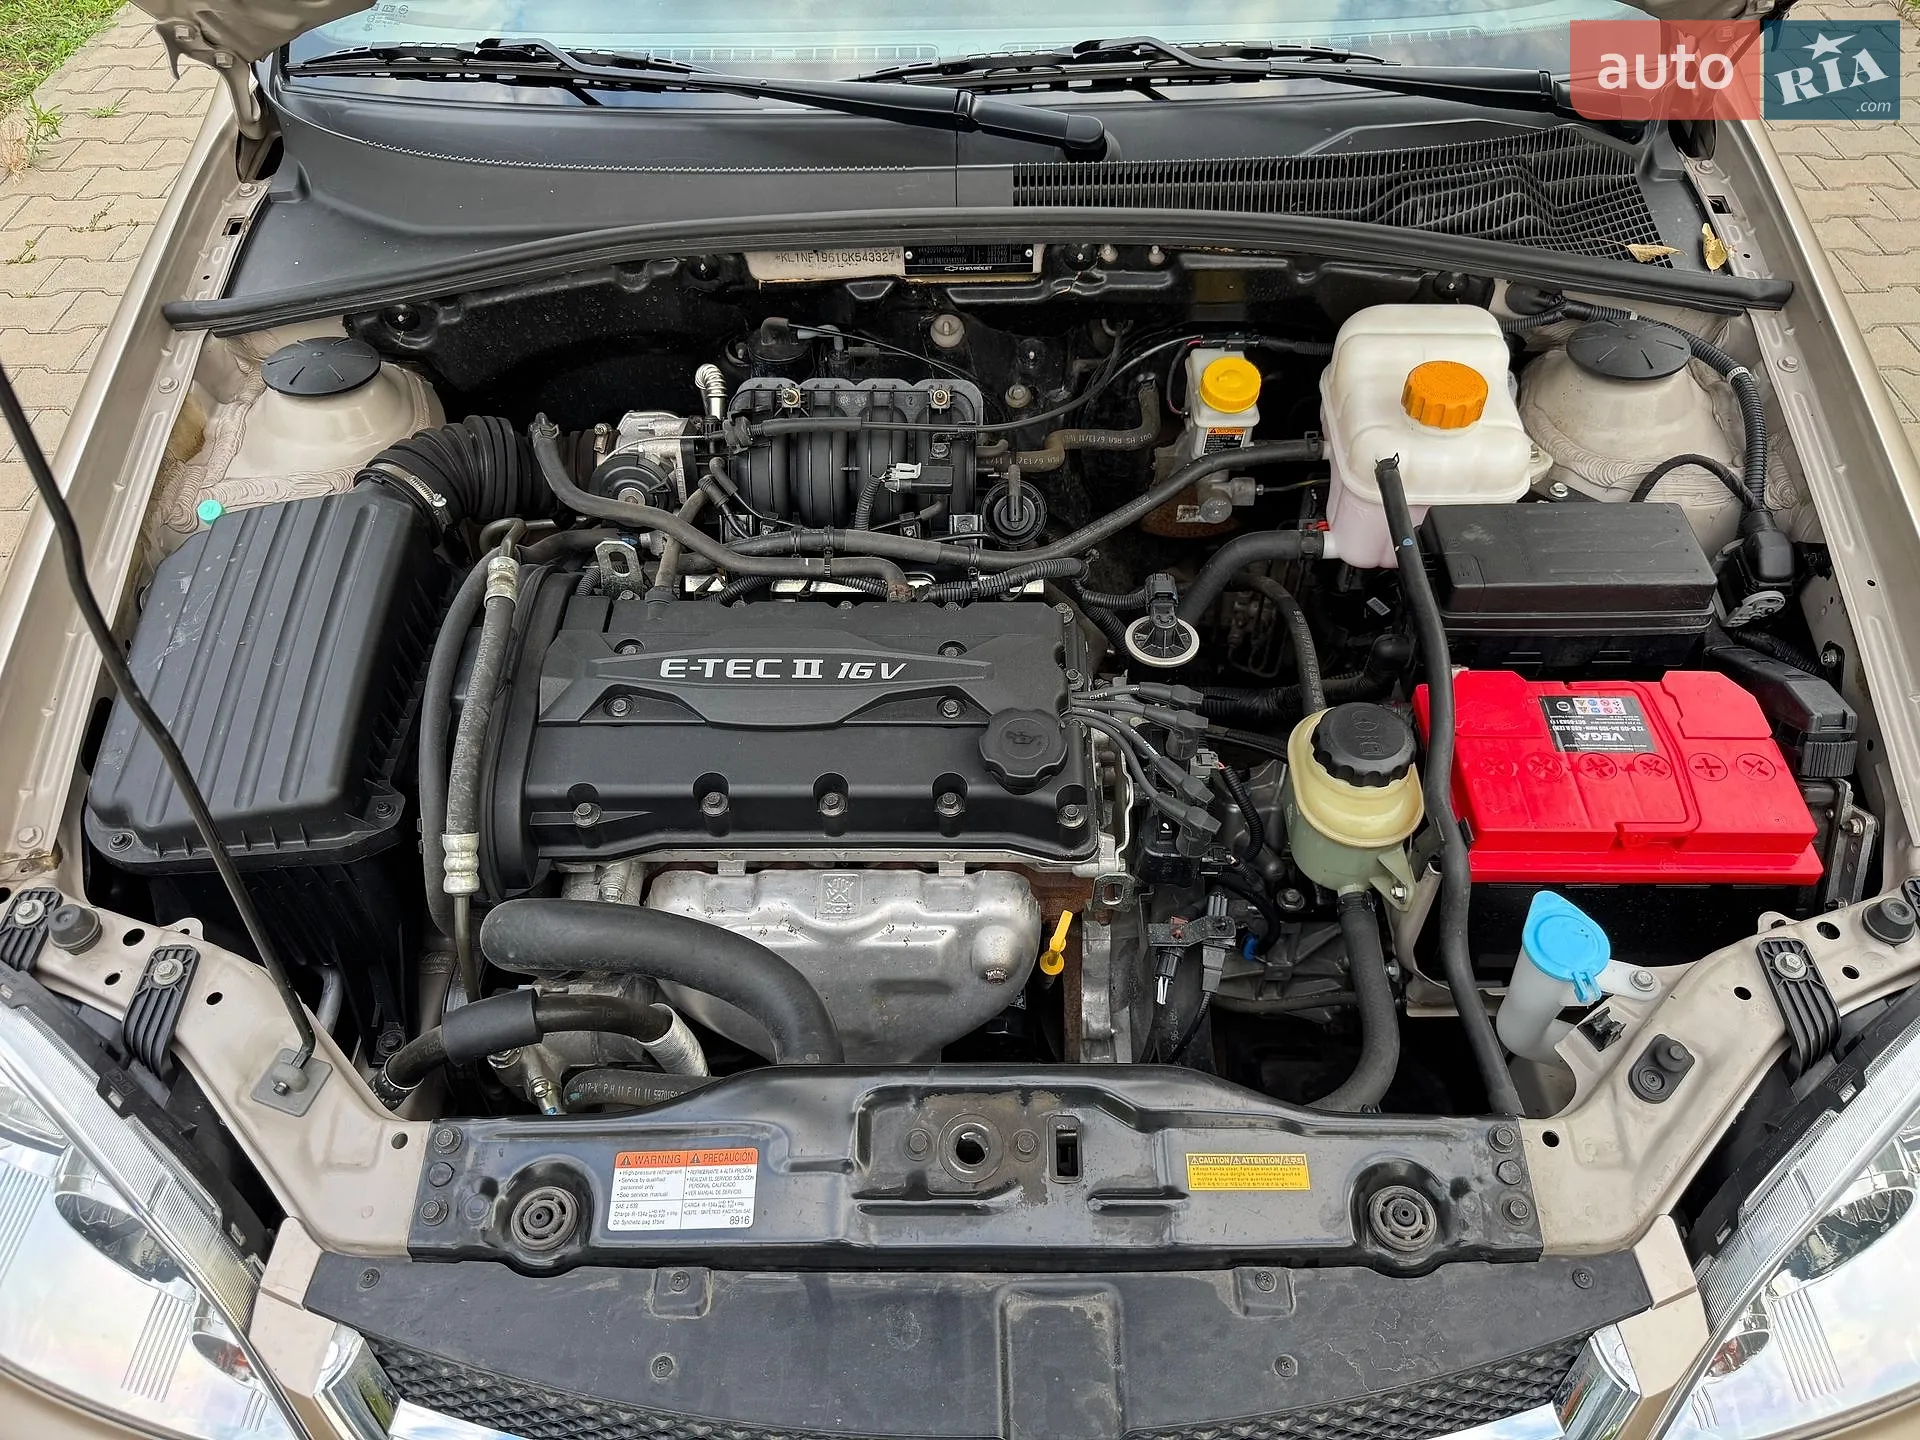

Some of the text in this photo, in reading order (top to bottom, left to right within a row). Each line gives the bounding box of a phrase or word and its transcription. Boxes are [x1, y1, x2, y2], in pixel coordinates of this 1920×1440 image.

[659, 658, 783, 678] E-TEC
[1577, 732, 1625, 741] VEGA
[634, 1154, 681, 1165] WARNING
[729, 1215, 750, 1225] 8916
